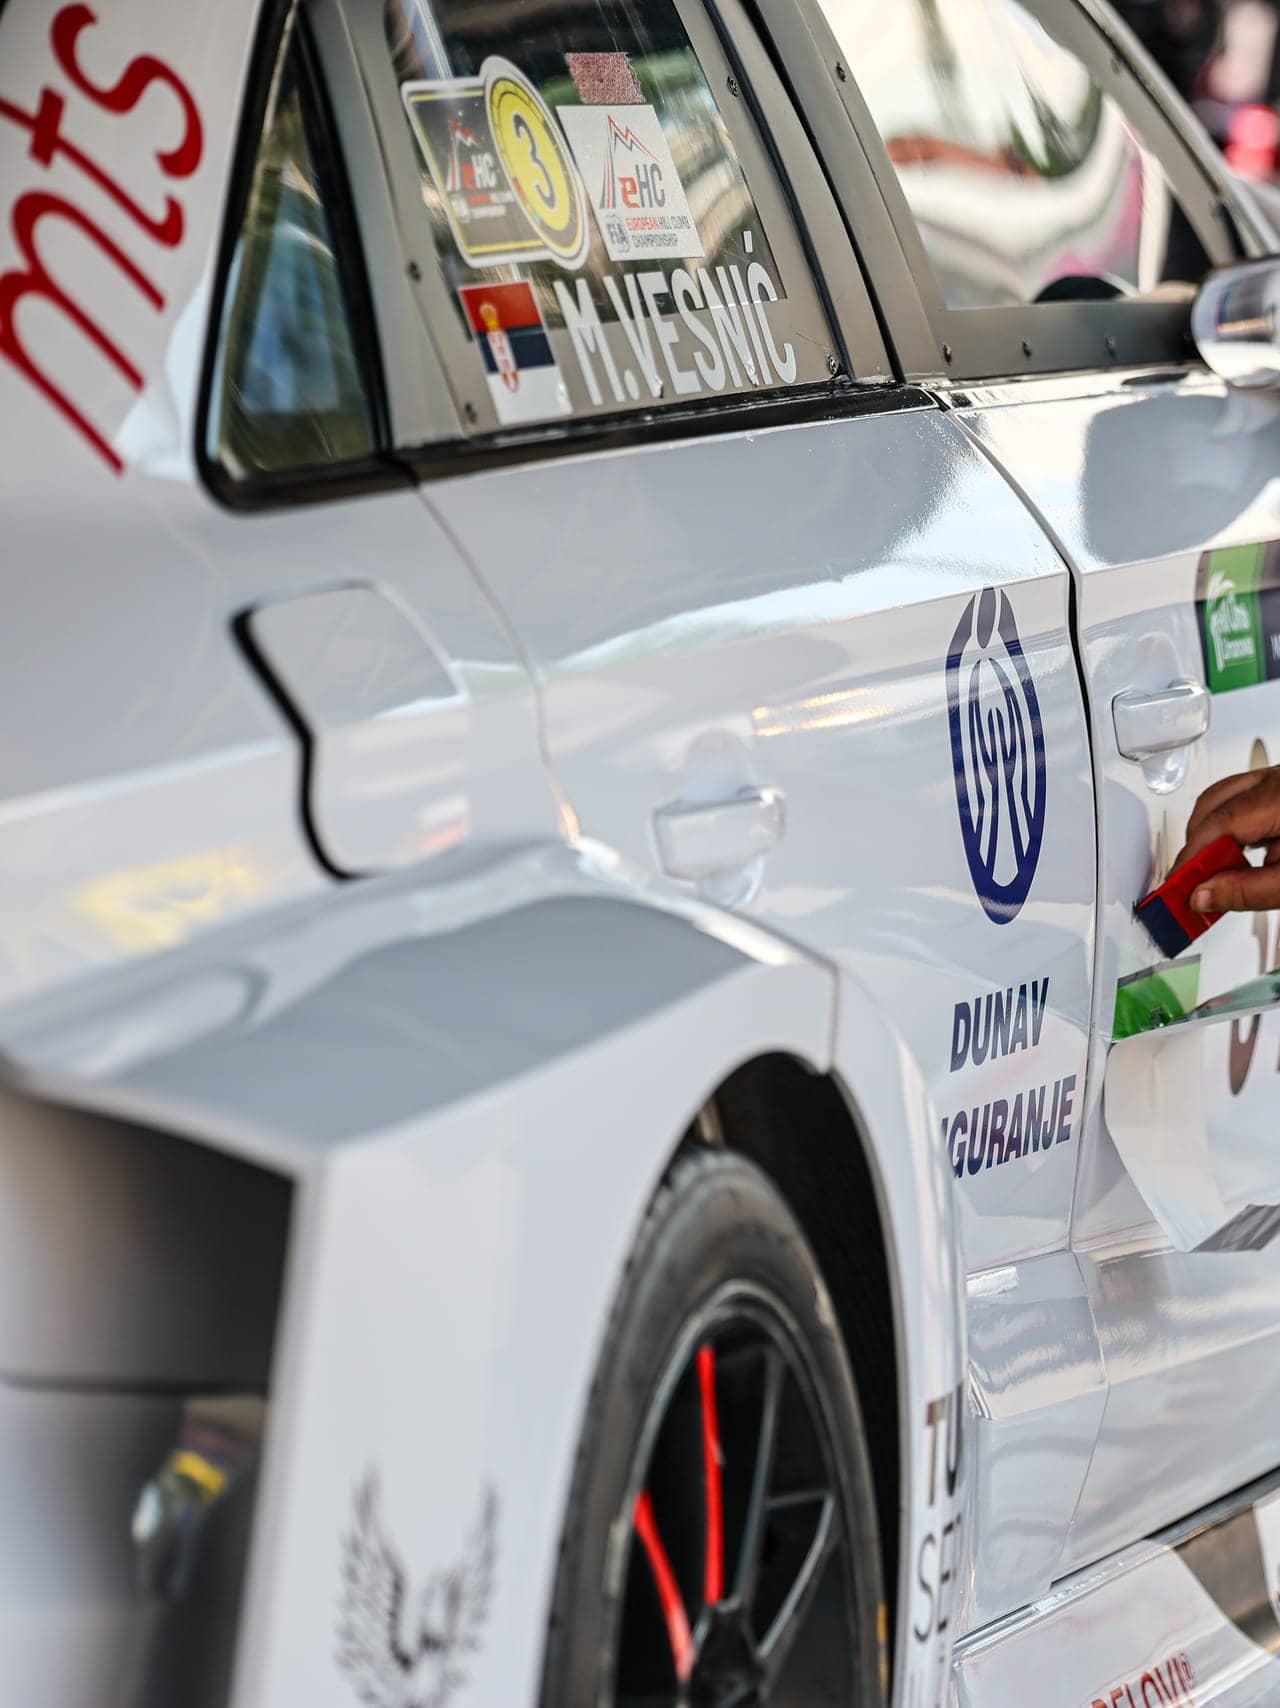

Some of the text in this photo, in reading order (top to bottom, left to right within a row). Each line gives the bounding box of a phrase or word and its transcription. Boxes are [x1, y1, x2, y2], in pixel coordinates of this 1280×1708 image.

[512, 112, 558, 211] 3
[617, 163, 666, 209] eHC
[0, 3, 205, 475] mts
[950, 976, 1050, 1073] DUNAV
